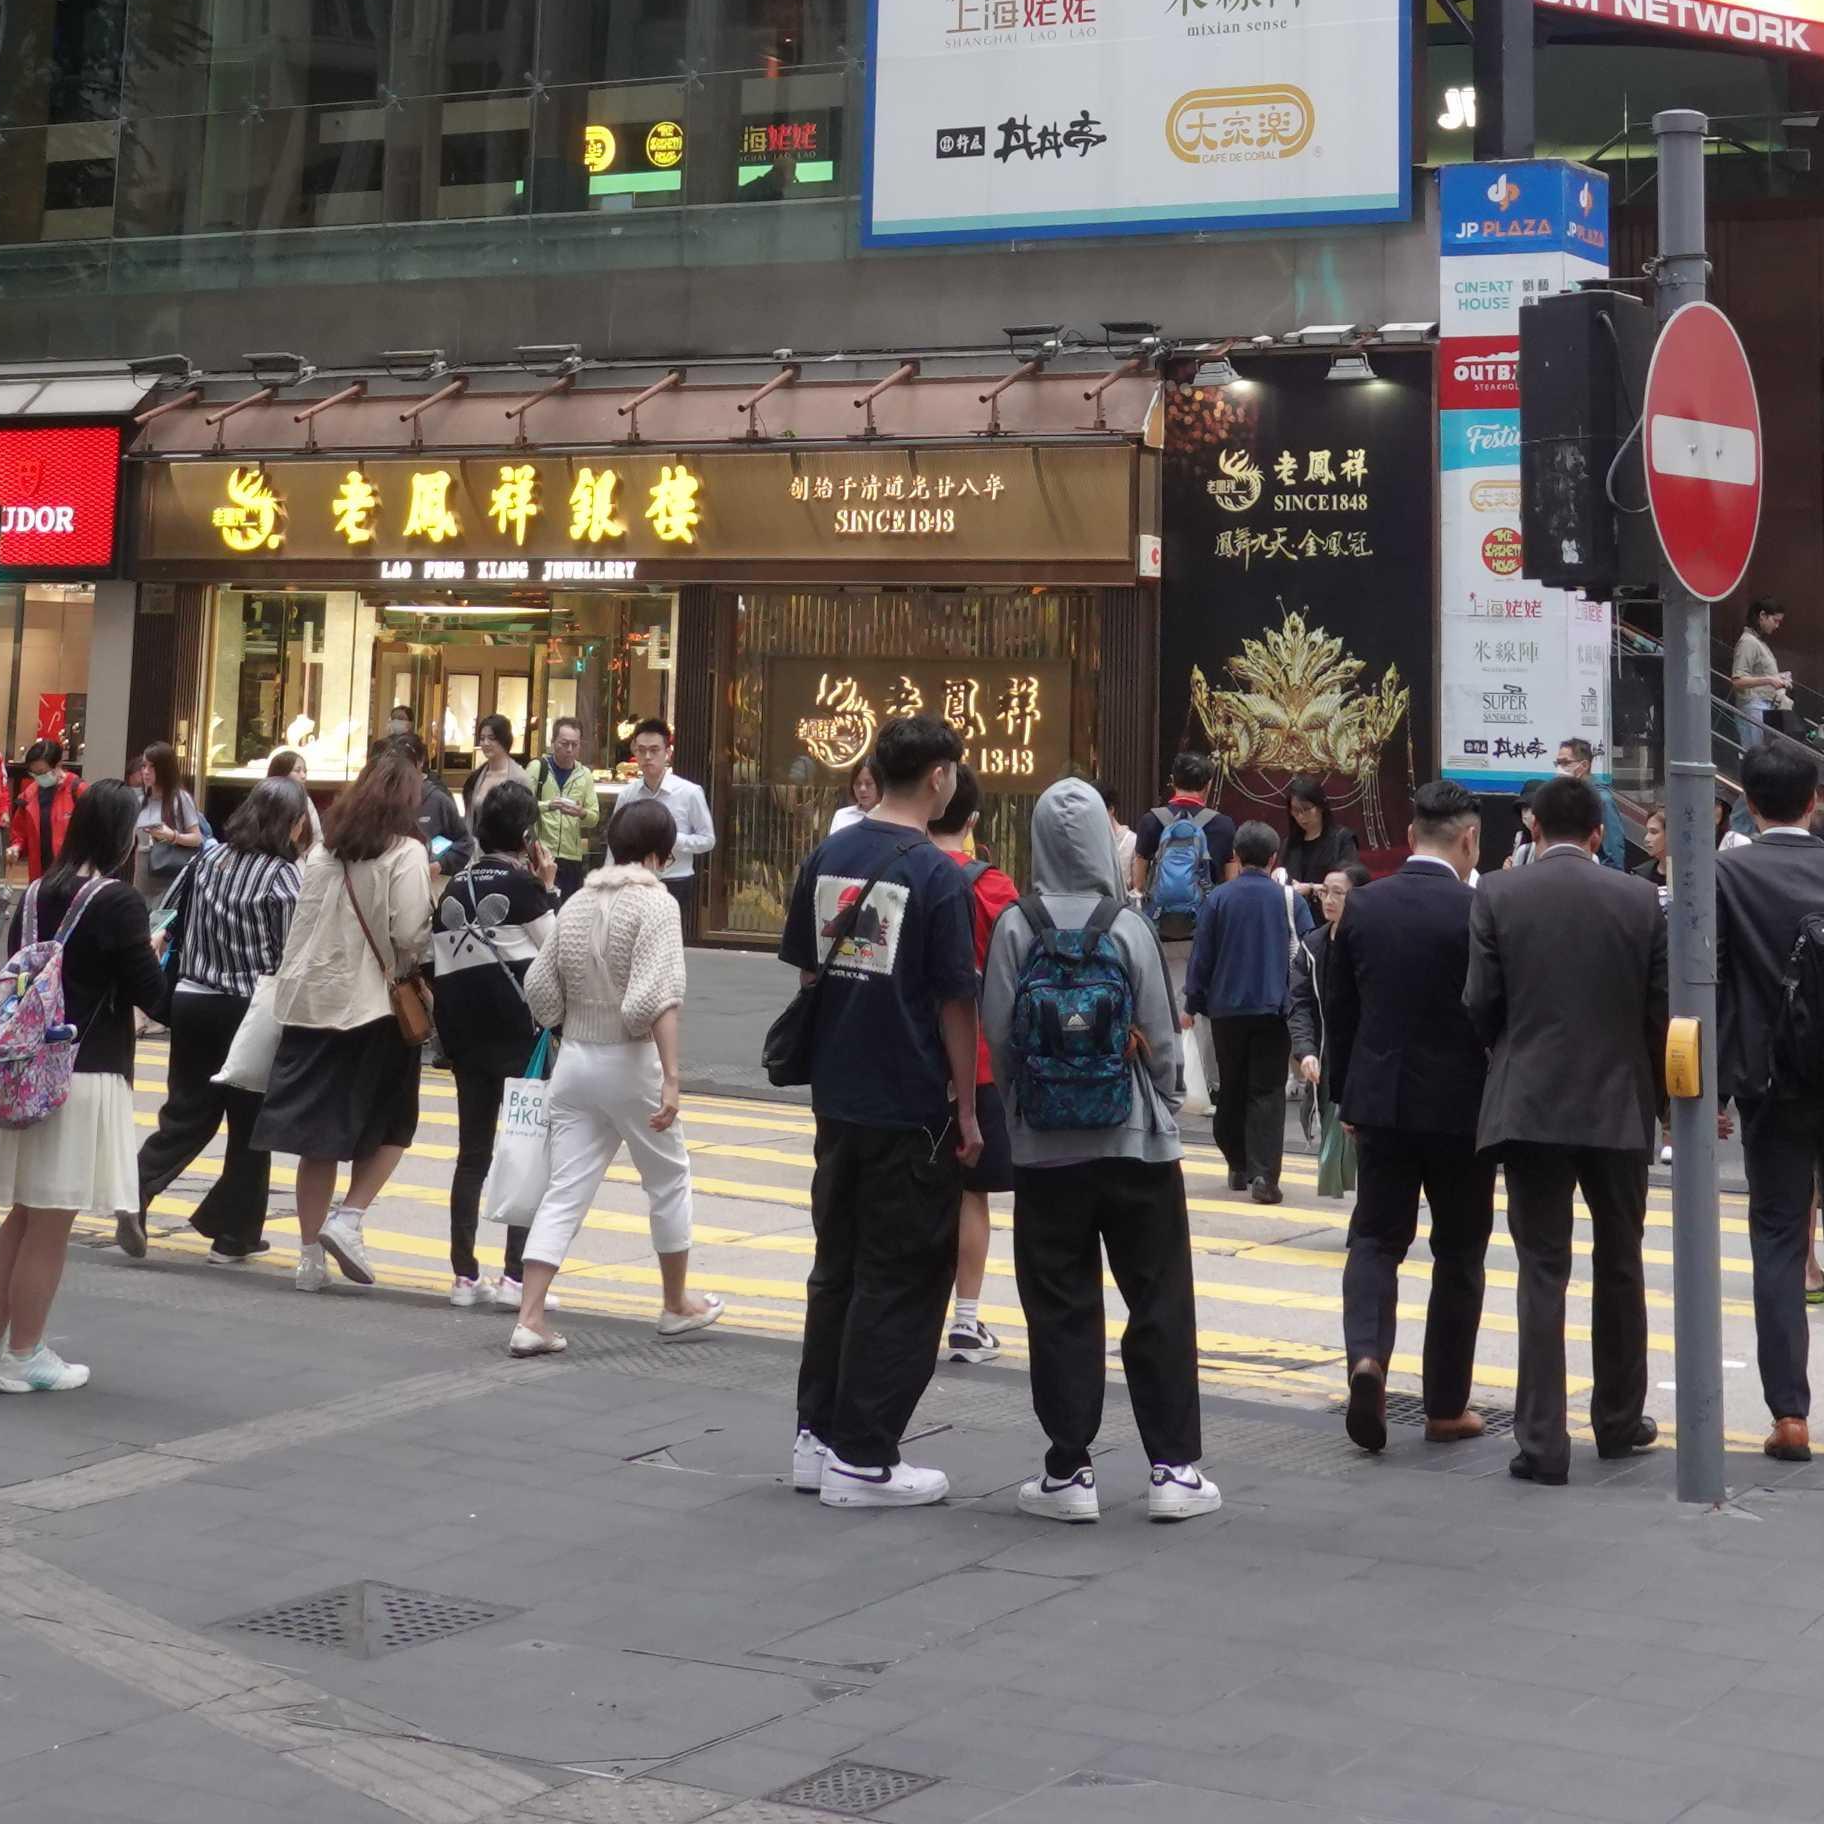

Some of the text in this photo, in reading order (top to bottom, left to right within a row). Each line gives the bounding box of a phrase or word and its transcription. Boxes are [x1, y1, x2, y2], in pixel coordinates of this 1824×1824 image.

[1187, 18, 1287, 37] mixian sense
[944, 27, 1096, 48] SHANGHAI LAO LAO
[740, 123, 817, 153] 海姥姥
[1456, 218, 1552, 238] JP PLAZA
[1454, 280, 1513, 294] CINEART
[1458, 297, 1510, 310] HOUSE
[1454, 364, 1520, 381] OUTB
[1273, 448, 1368, 487] 老鳳祥
[1, 506, 73, 534] UDOR
[382, 562, 412, 578] LAO
[478, 562, 528, 579] XIANG
[542, 562, 637, 580] JEWELLERY
[1482, 695, 1527, 710] SUPER
[510, 1090, 528, 1107] Be
